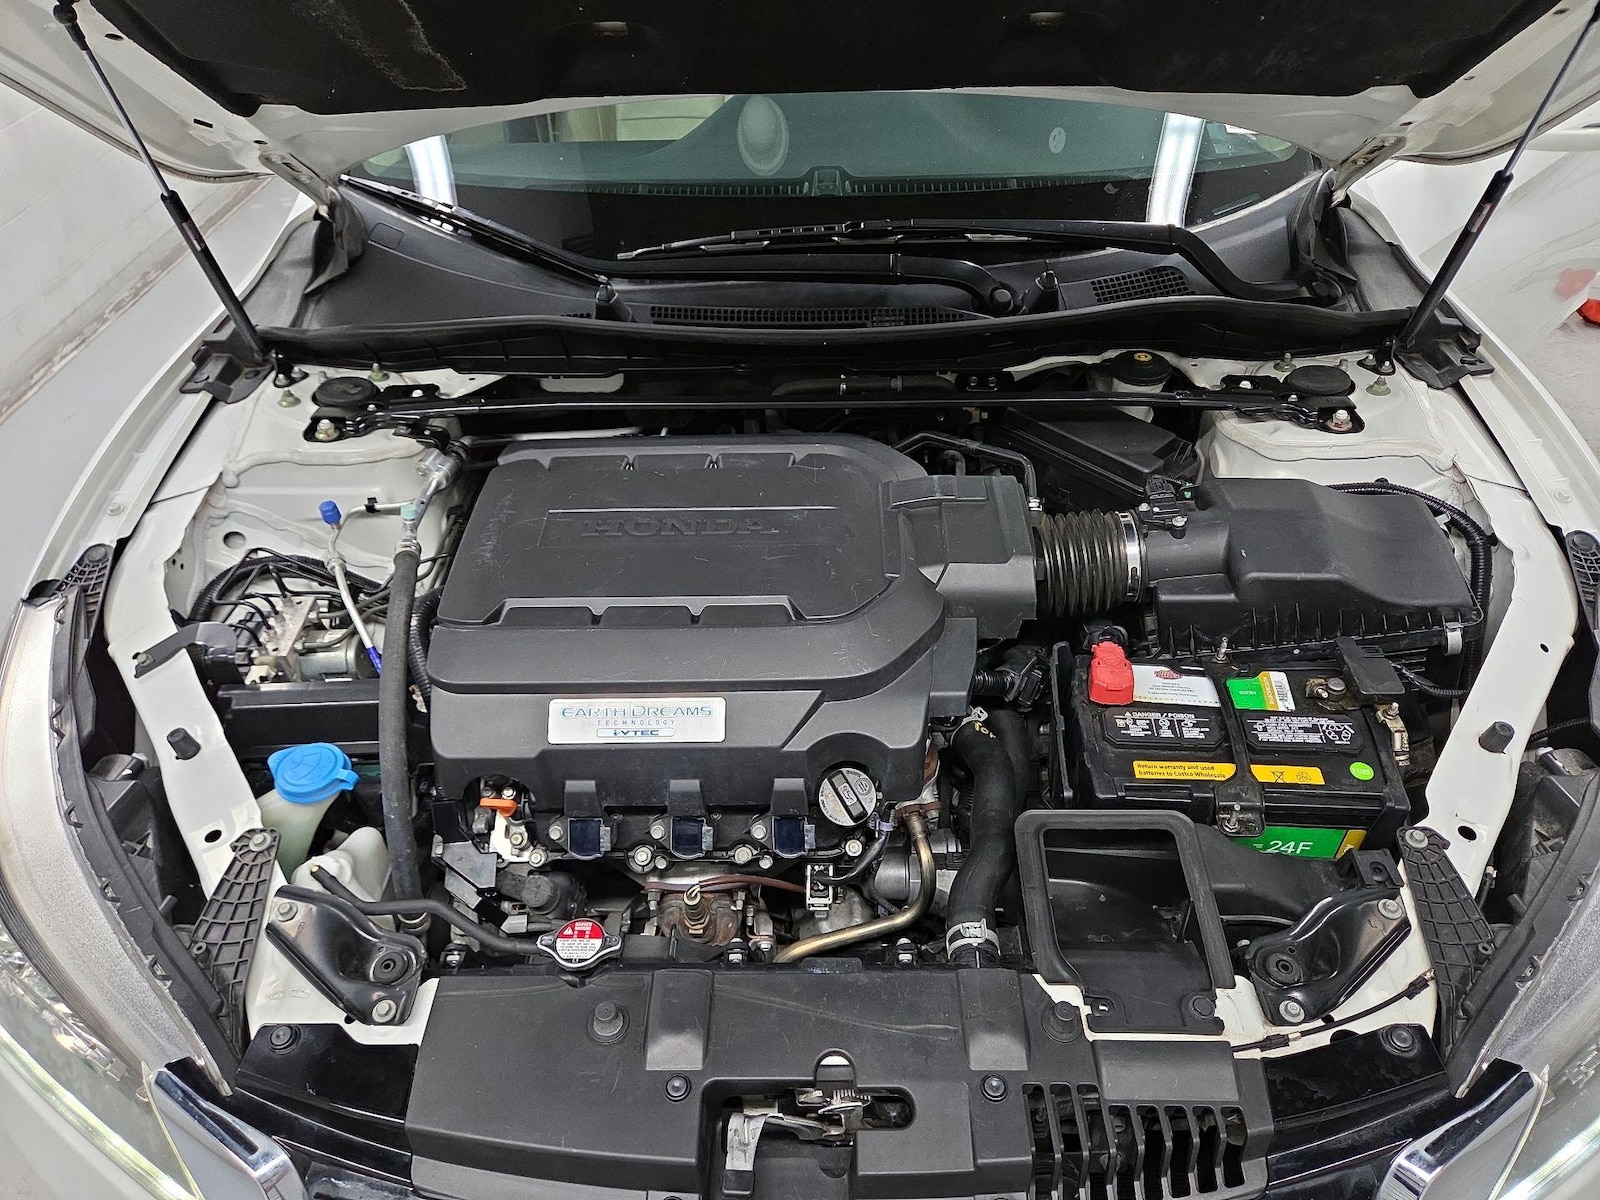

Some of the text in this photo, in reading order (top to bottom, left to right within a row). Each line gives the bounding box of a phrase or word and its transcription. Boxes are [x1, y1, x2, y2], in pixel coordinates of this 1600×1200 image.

[581, 518, 779, 537] HONDA
[562, 705, 713, 718] EARTH DREAMS
[1132, 711, 1161, 719] DANGER
[1168, 712, 1195, 720] POISON
[1265, 840, 1314, 854] 24F
